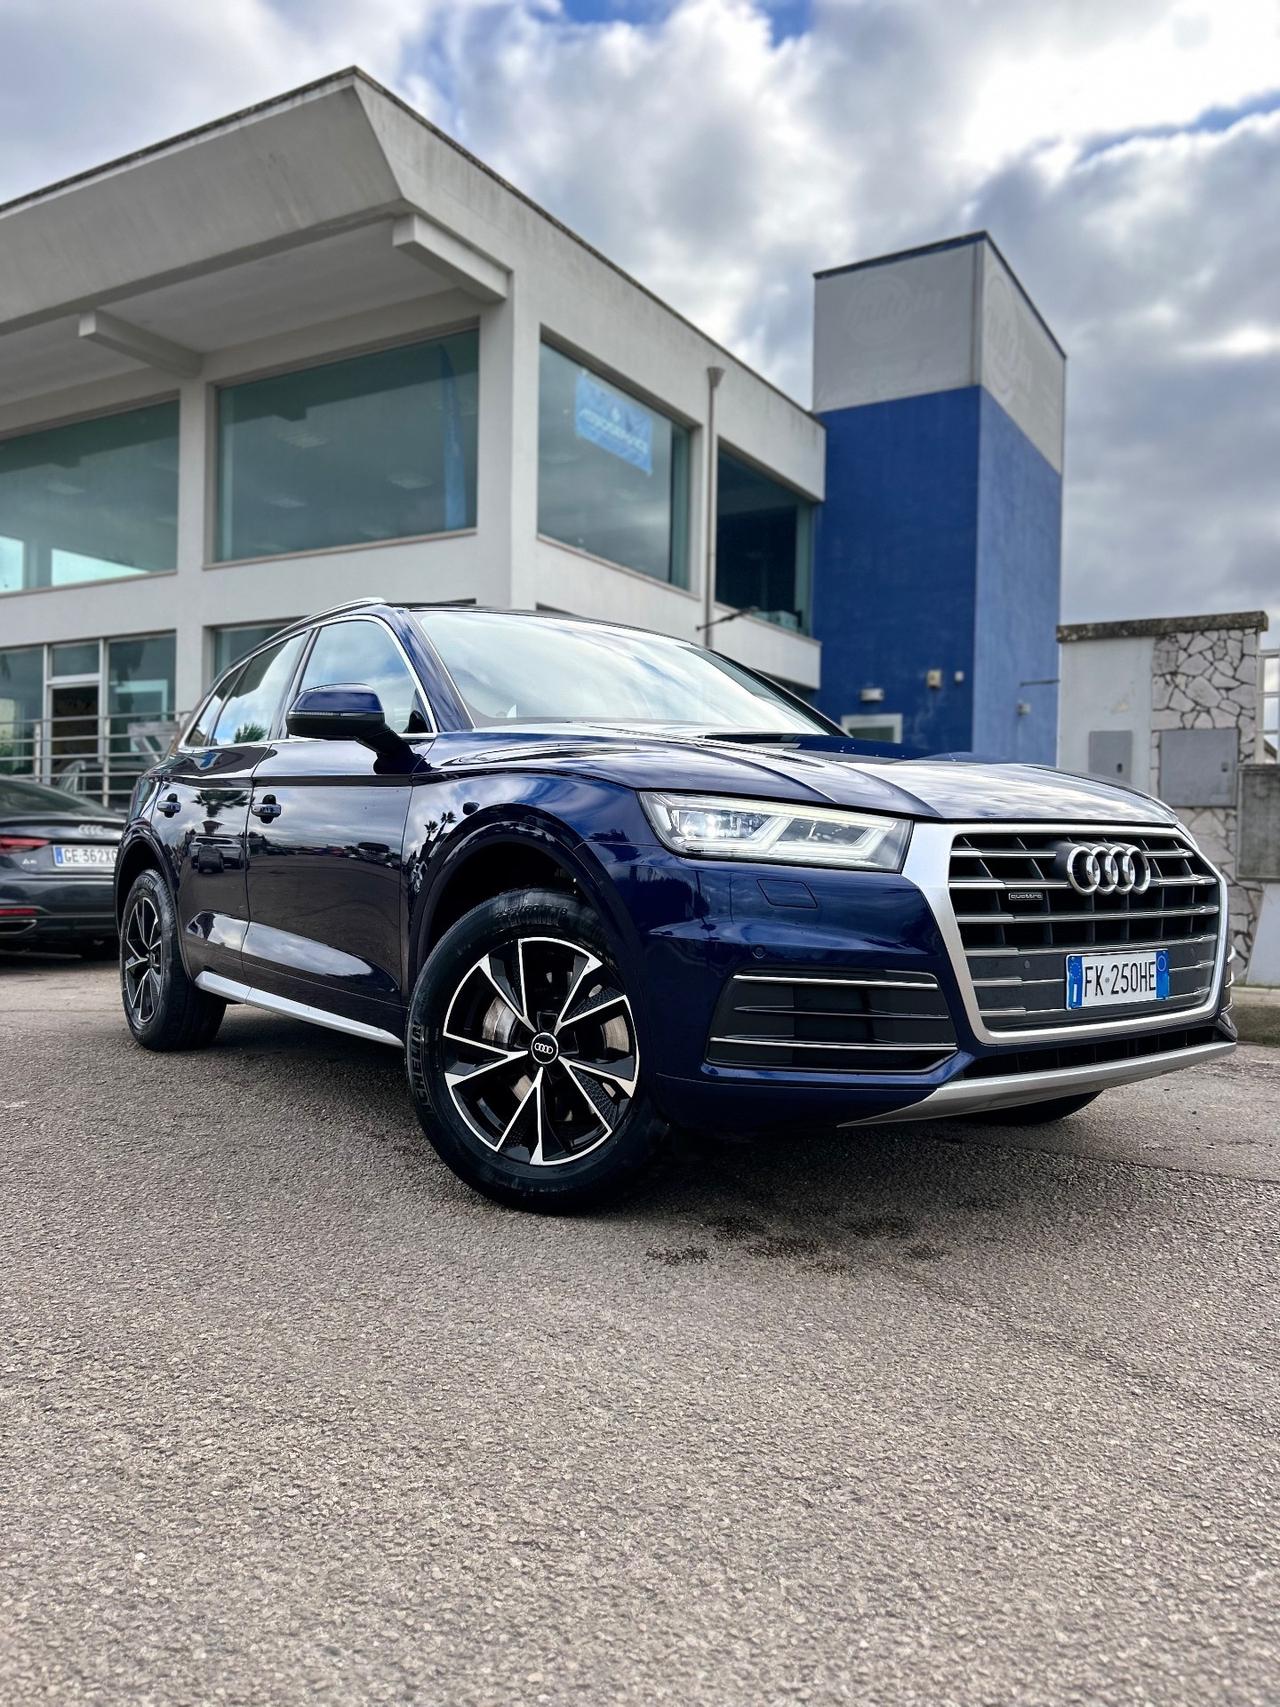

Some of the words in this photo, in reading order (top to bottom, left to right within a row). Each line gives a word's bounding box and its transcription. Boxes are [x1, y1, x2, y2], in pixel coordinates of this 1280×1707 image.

[64, 849, 79, 862] GE
[1084, 965, 1104, 997] FK
[1110, 961, 1156, 995] 250HE
